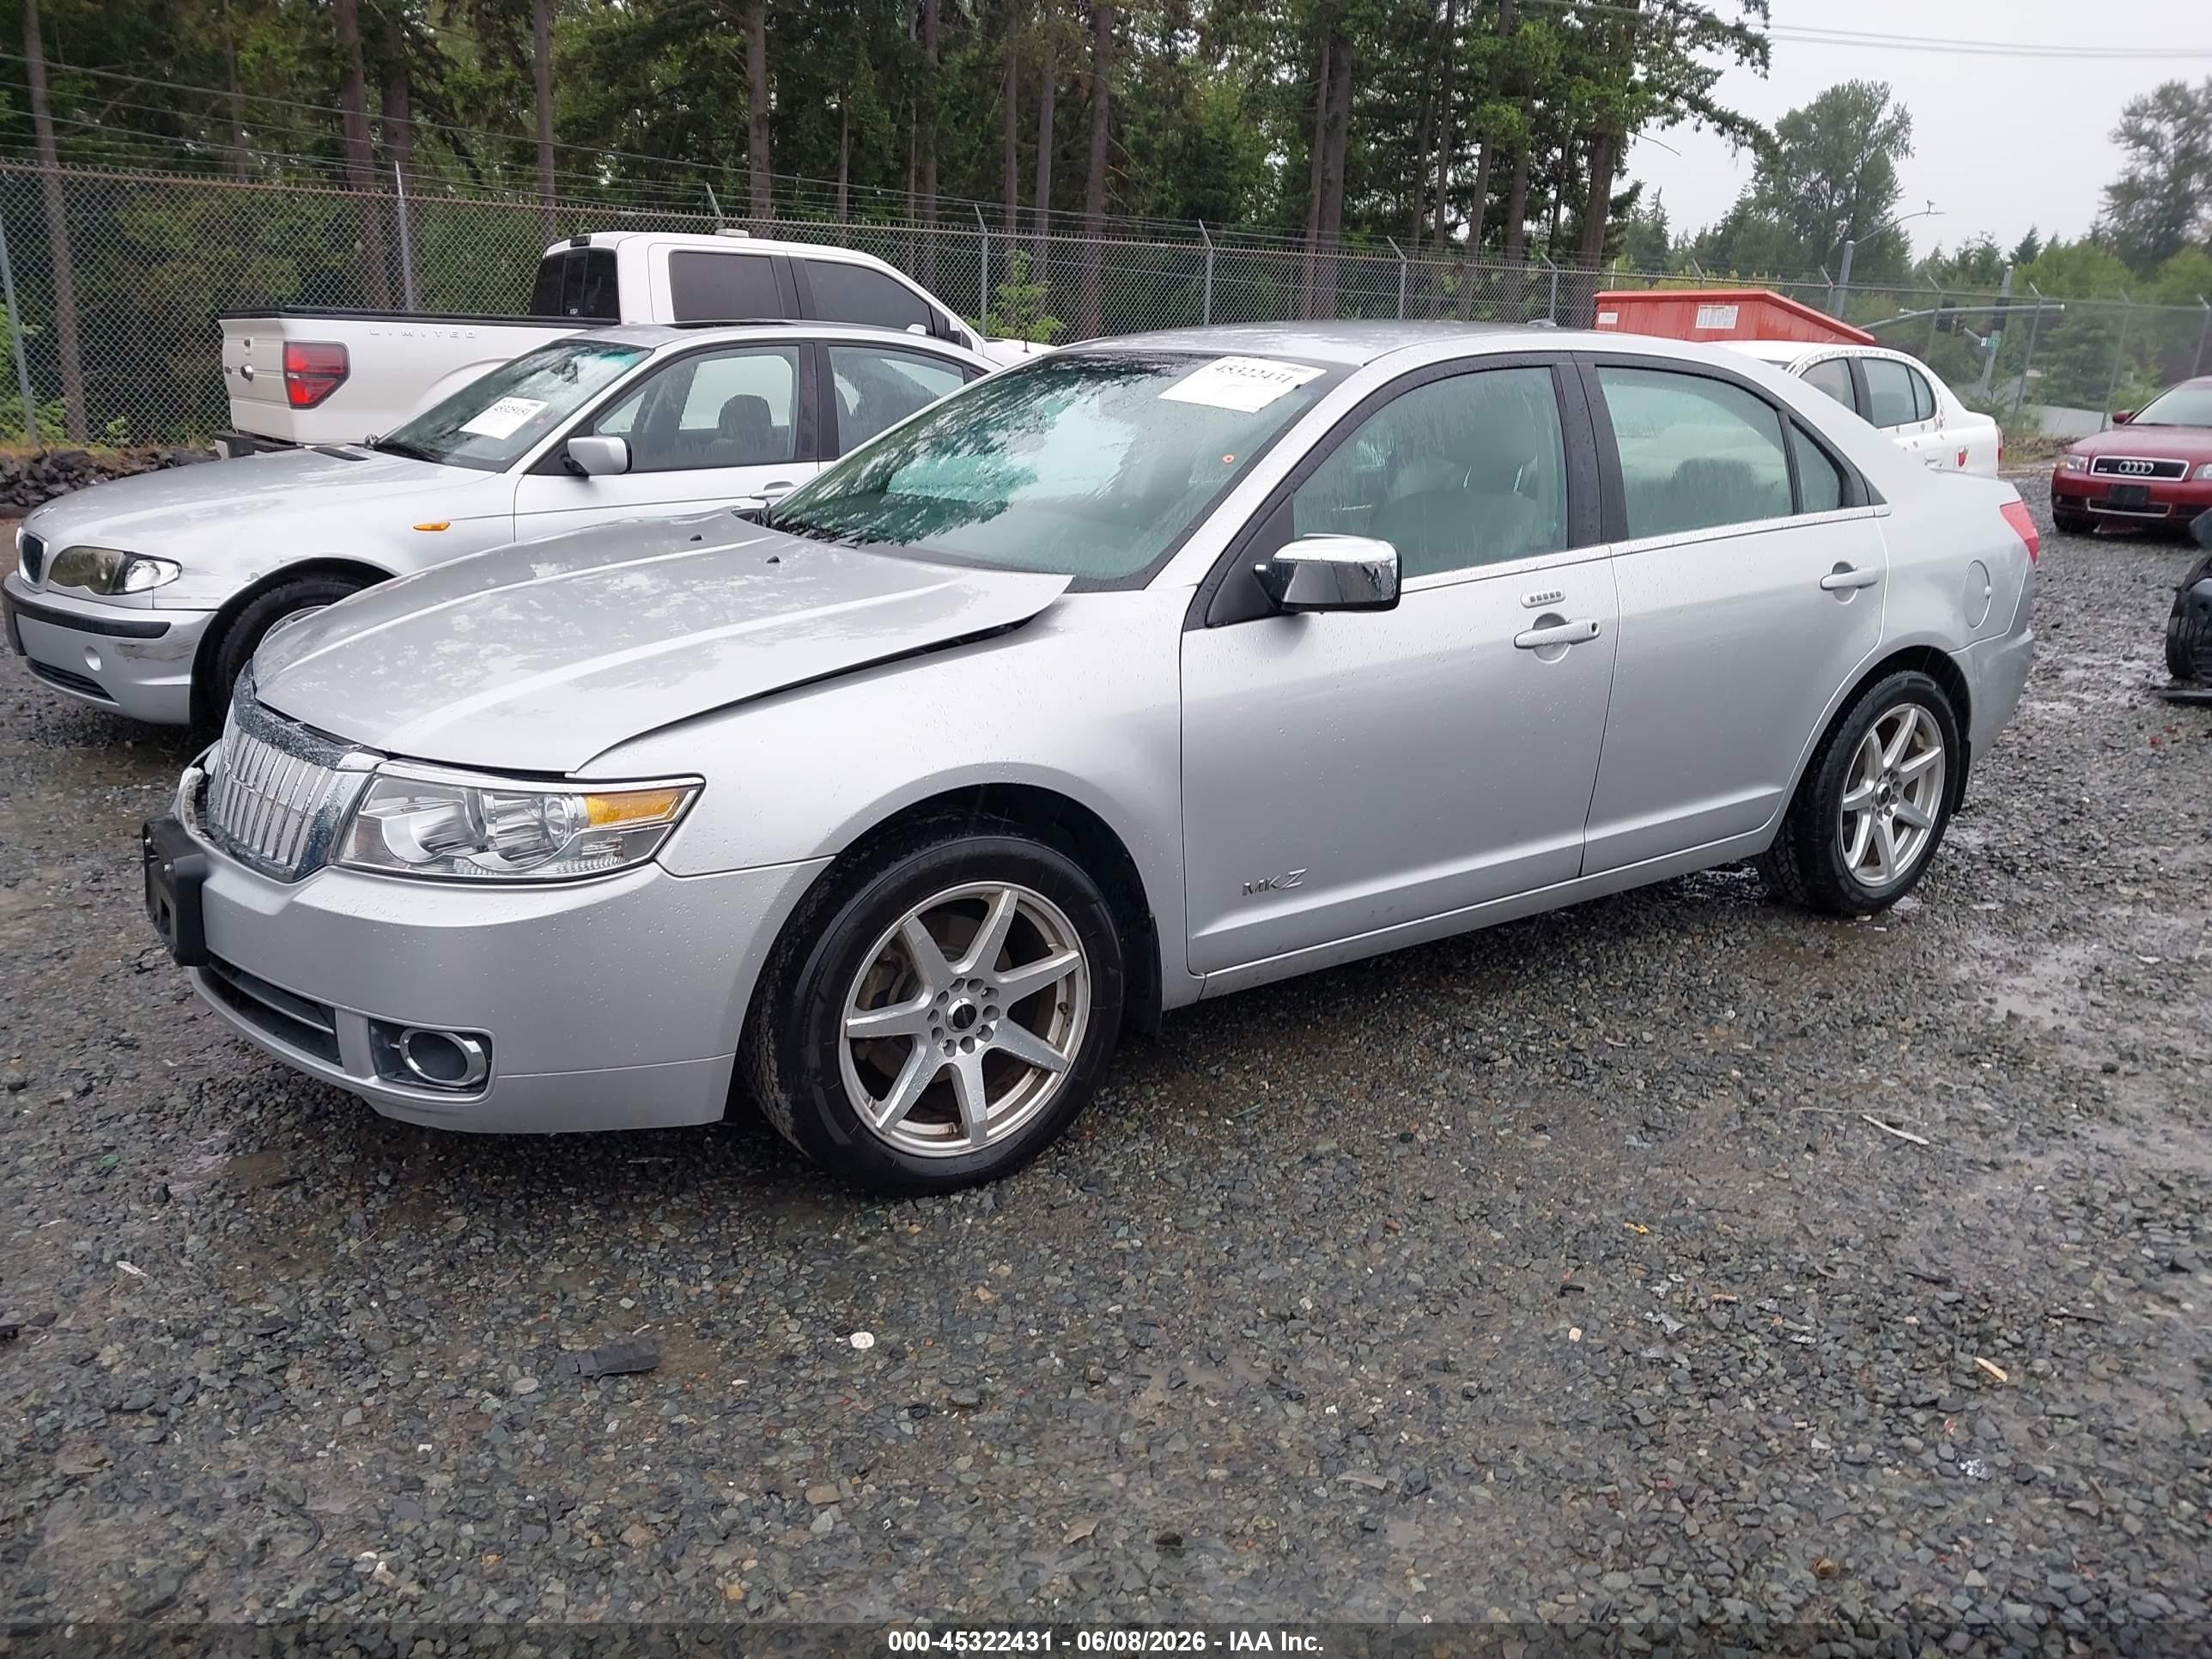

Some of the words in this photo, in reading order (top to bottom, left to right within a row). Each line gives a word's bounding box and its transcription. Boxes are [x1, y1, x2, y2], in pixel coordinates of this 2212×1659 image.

[369, 329, 476, 339] LIMITED
[1215, 363, 1295, 384] 45322431
[1242, 866, 1308, 896] MKZ
